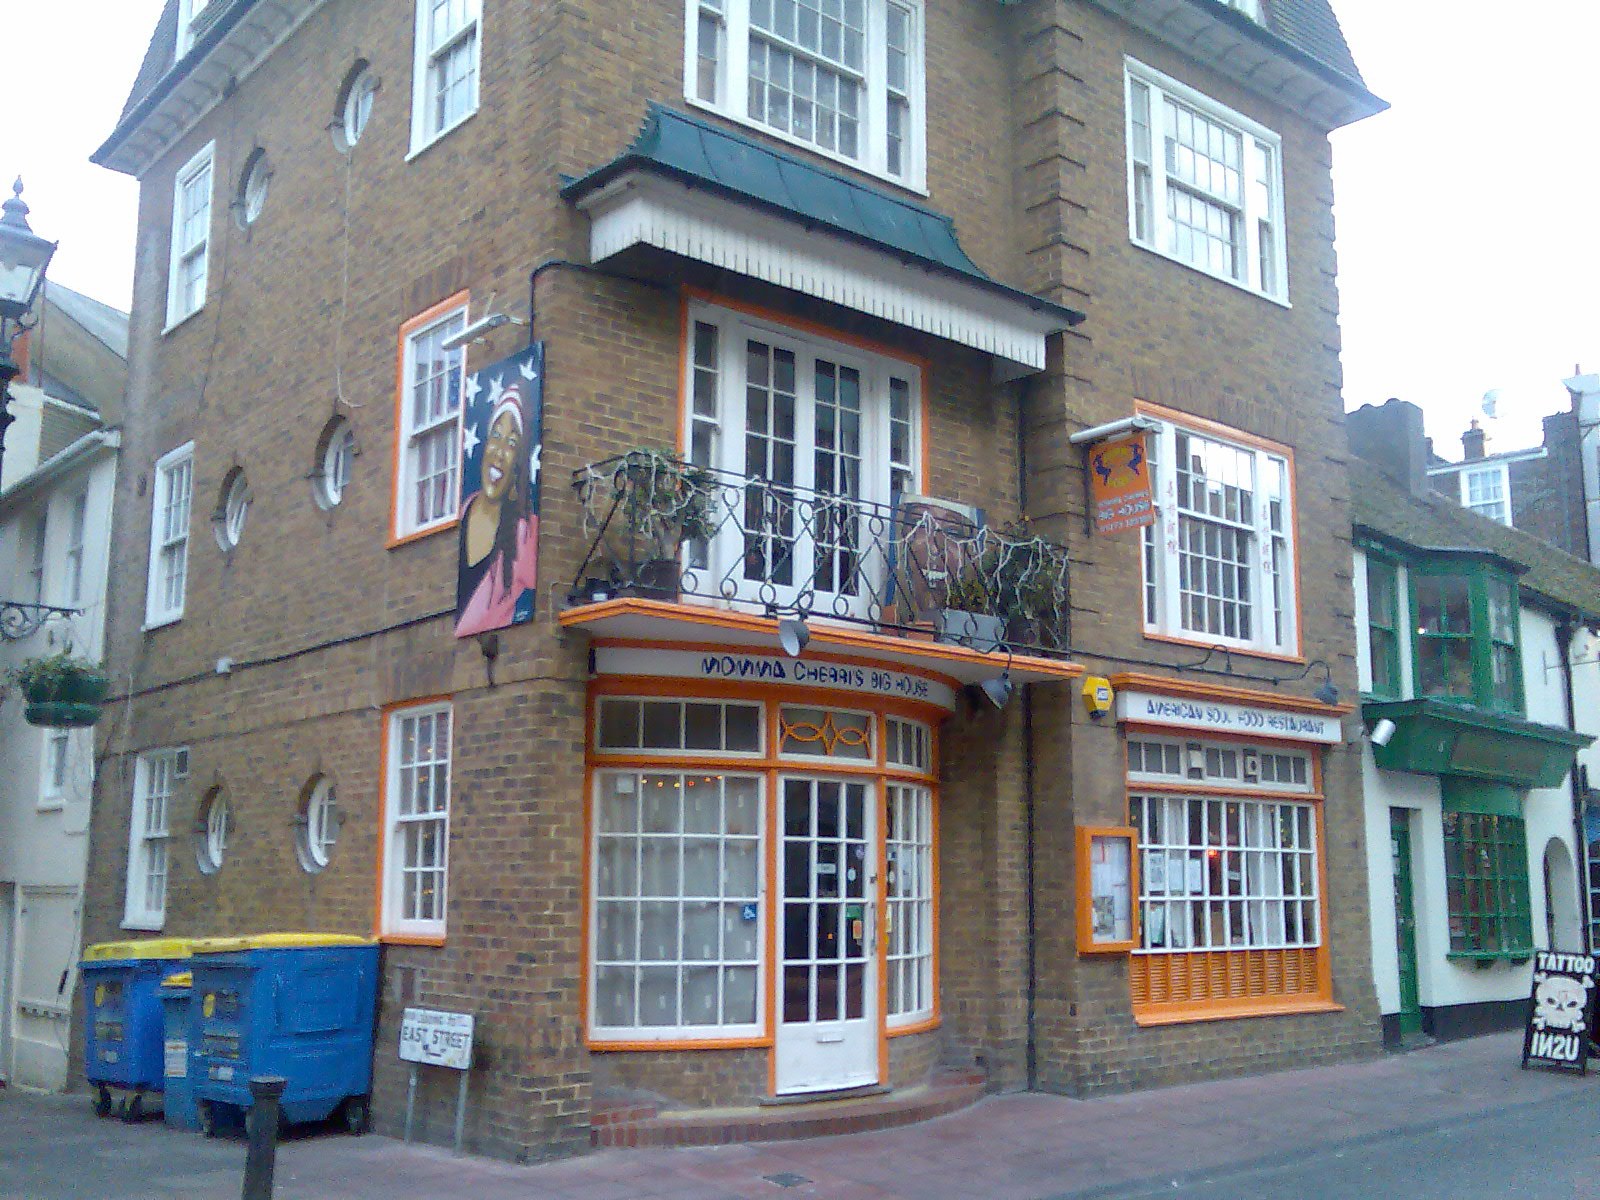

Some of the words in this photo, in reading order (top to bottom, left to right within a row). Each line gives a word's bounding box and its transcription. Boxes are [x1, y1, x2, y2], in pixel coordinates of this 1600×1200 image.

[702, 656, 786, 679] MOMMA
[871, 671, 892, 690] BIG
[896, 679, 929, 697] HOUSE
[1147, 699, 1203, 720] AMERICAN
[1207, 706, 1231, 724] SOUL
[1237, 713, 1264, 728] FOOD
[1267, 716, 1325, 735] RESTAURANT
[1538, 952, 1595, 974] TATTOO
[402, 1026, 428, 1042] EAST
